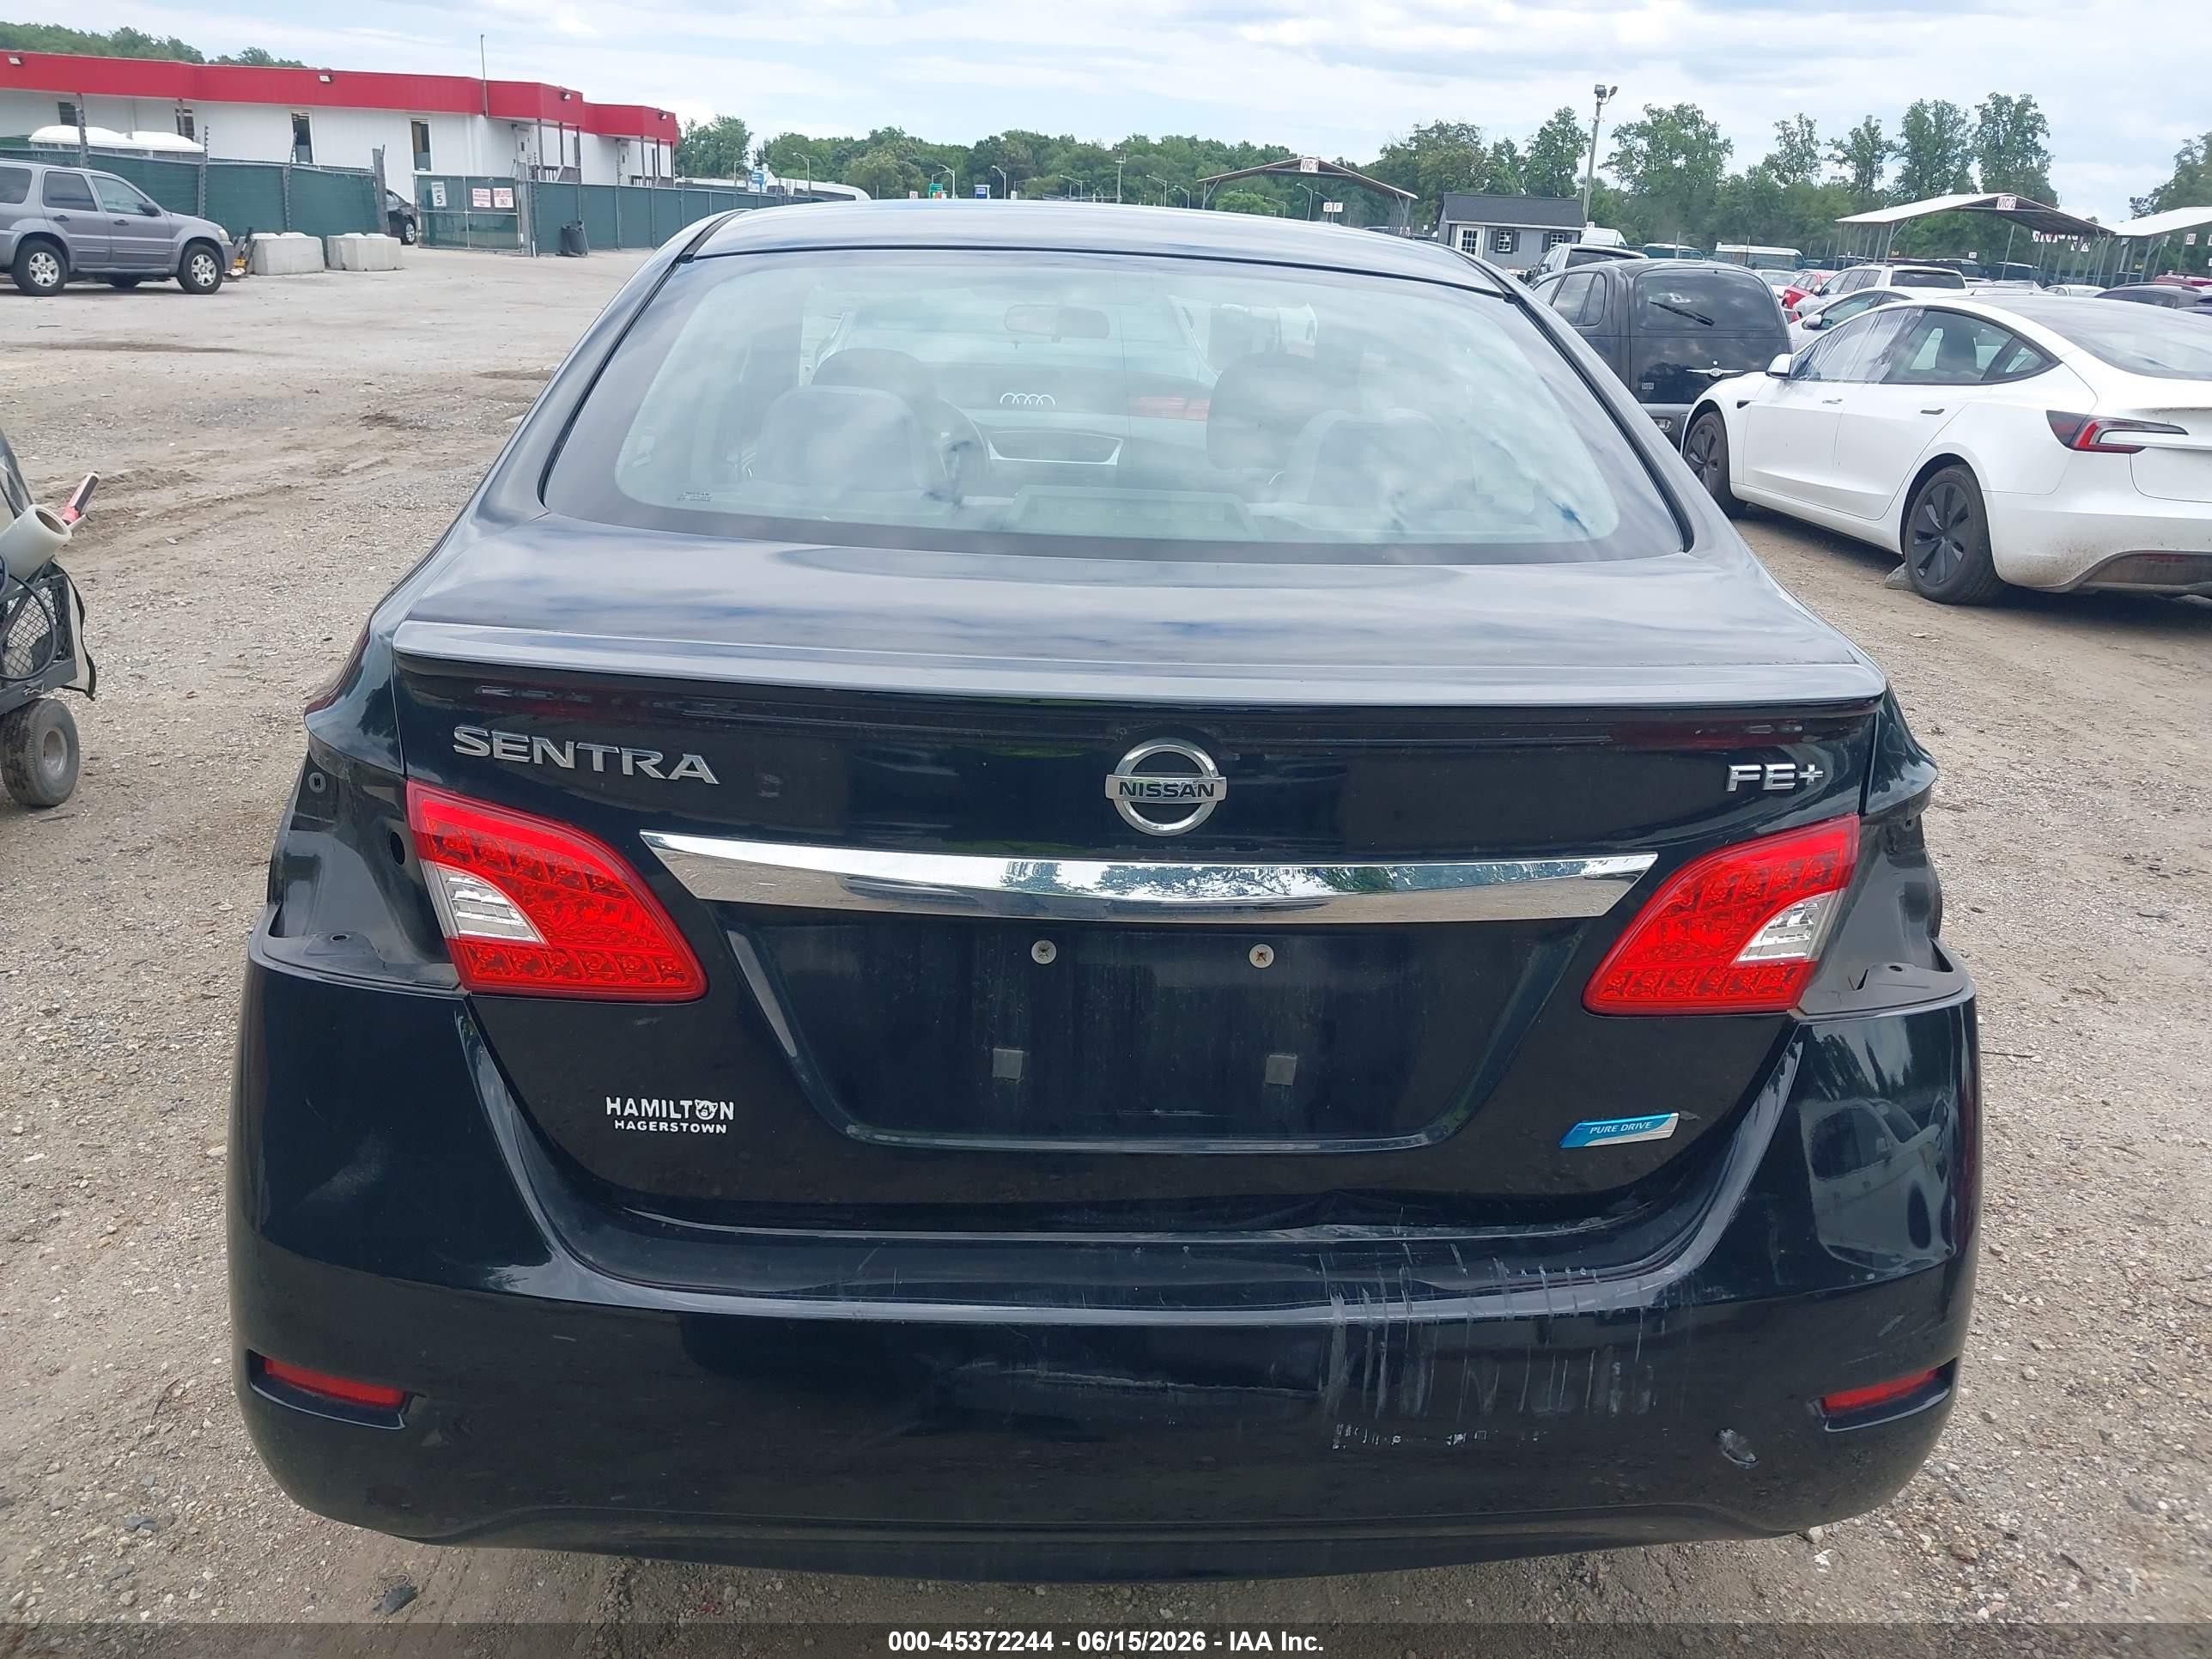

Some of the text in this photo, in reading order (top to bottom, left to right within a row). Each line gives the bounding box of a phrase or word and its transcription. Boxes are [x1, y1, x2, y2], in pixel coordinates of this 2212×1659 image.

[1302, 161, 1313, 171] VIC
[436, 195, 442, 204] 5
[453, 726, 720, 785] SENTRA
[1727, 763, 1823, 792] FE+
[1119, 781, 1214, 798] NISSAN
[605, 1097, 734, 1120] HAMILTON
[614, 1120, 727, 1133] HAGERSTOWN
[1589, 1121, 1653, 1133] PURE DRIVE
